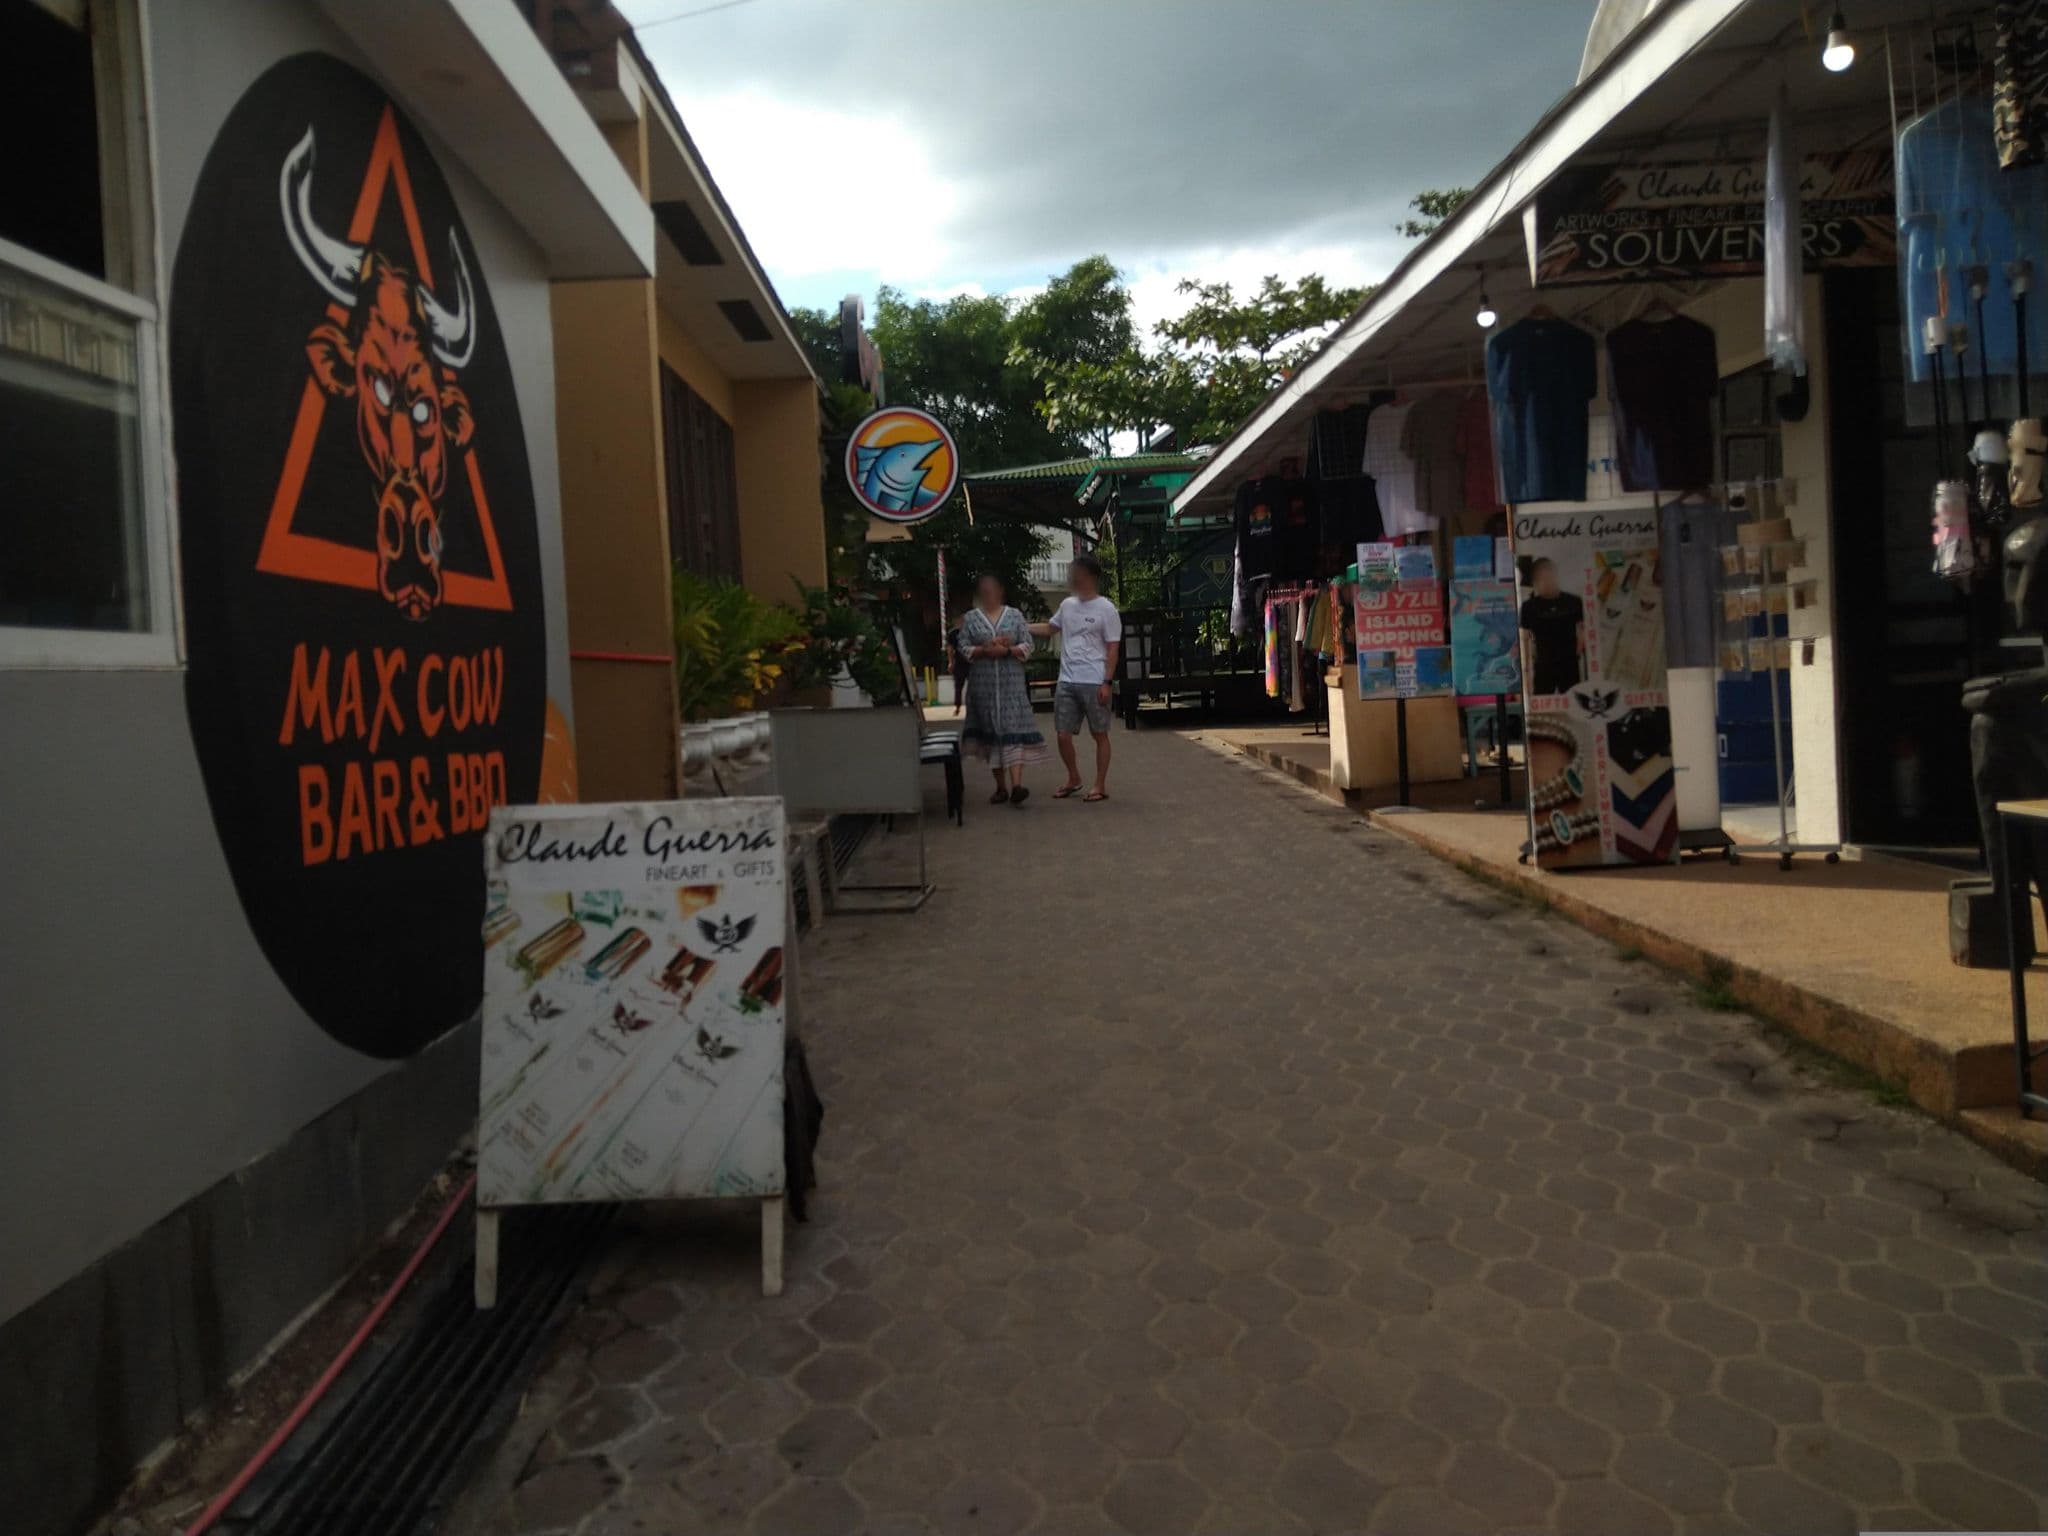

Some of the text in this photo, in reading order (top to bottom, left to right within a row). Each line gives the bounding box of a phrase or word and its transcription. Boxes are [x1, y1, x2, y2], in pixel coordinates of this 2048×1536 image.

[1637, 166, 1814, 202] Claude Gua
[1552, 209, 1648, 233] ARTWORKS
[1667, 205, 1737, 226] FINEART
[1587, 221, 1844, 270] SOUVENRS
[1514, 514, 1656, 539] Claude Guerra
[1366, 614, 1433, 629] ISLAND
[1358, 630, 1444, 645] HOPPING
[277, 641, 504, 753] MAX COW
[1531, 697, 1569, 711] GIFTS
[1625, 692, 1665, 705] GIFTS
[297, 700, 406, 868] BAR
[408, 754, 446, 847] &
[497, 816, 776, 864] Claude Guerra
[646, 864, 707, 881] FINEART
[733, 862, 775, 878] GIFTS
